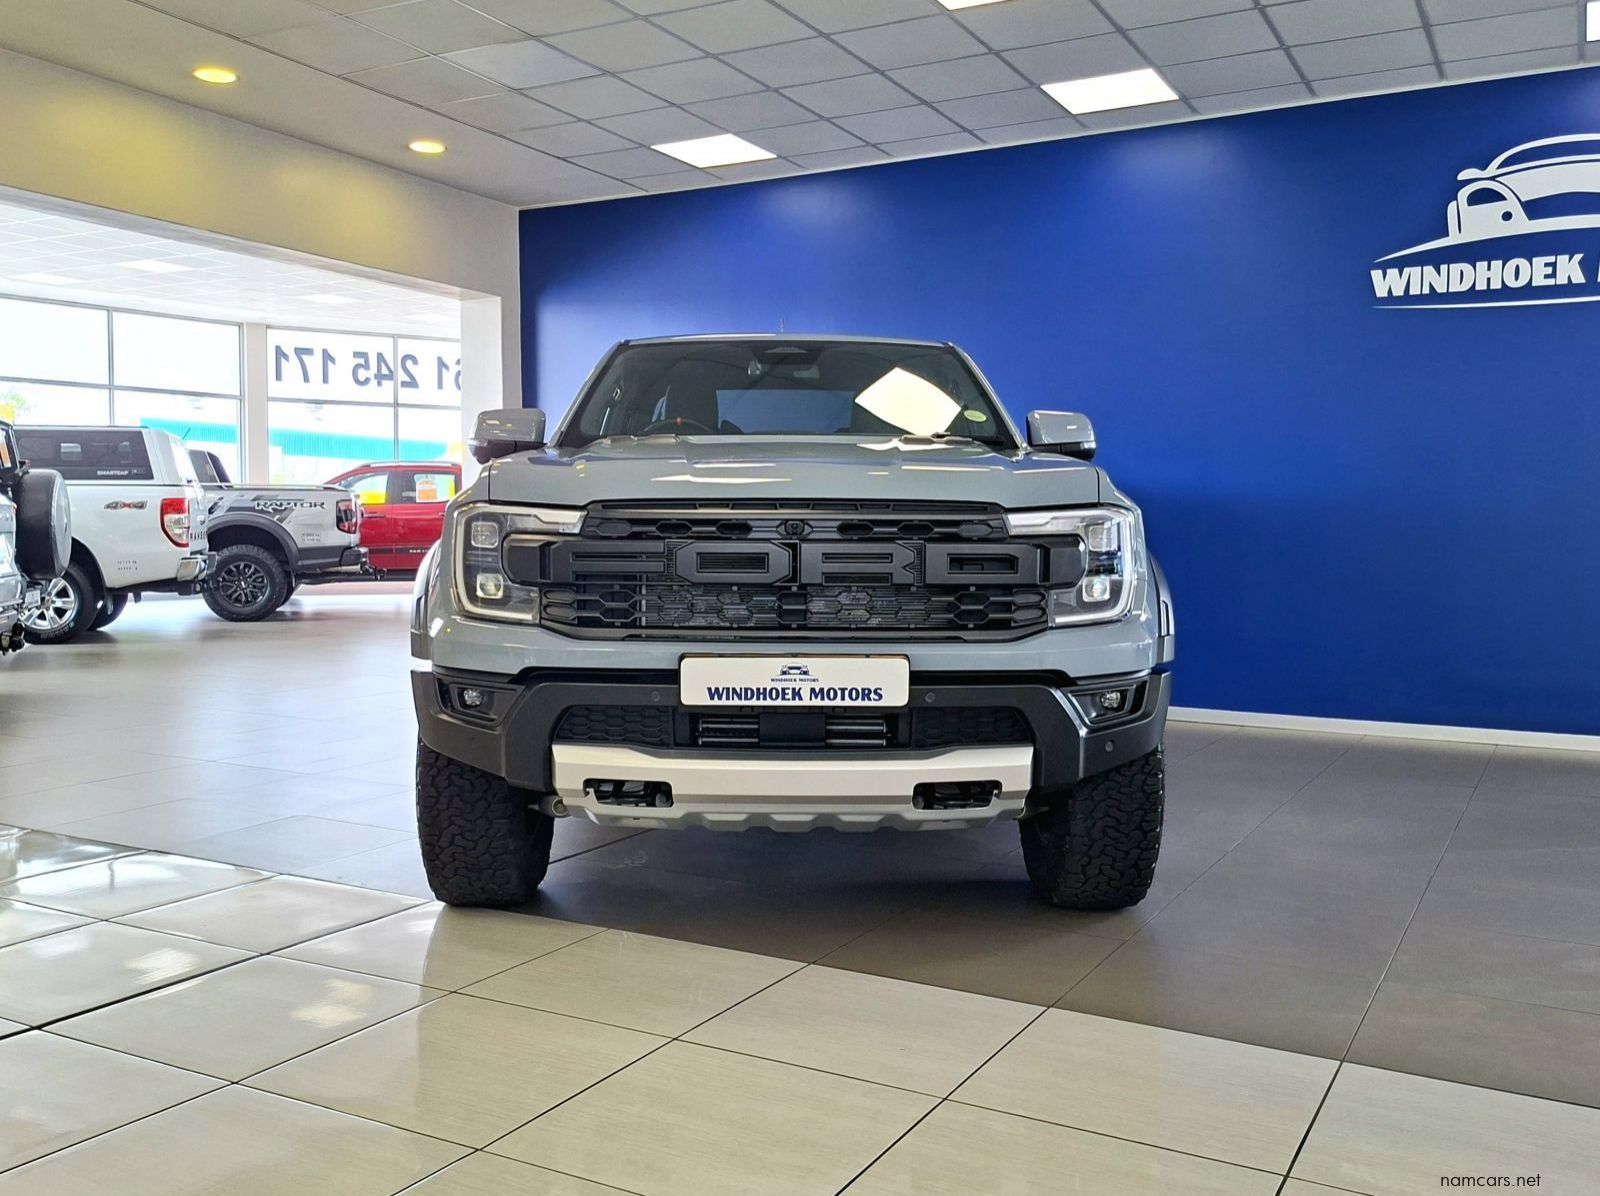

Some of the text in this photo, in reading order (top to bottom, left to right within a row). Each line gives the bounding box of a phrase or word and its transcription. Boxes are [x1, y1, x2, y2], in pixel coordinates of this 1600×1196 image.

[1370, 253, 1586, 298] WINDHOEK
[255, 501, 327, 513] RAPTOR
[549, 539, 1040, 585] FORD
[706, 687, 883, 701] WINDHOEK MOTORS
